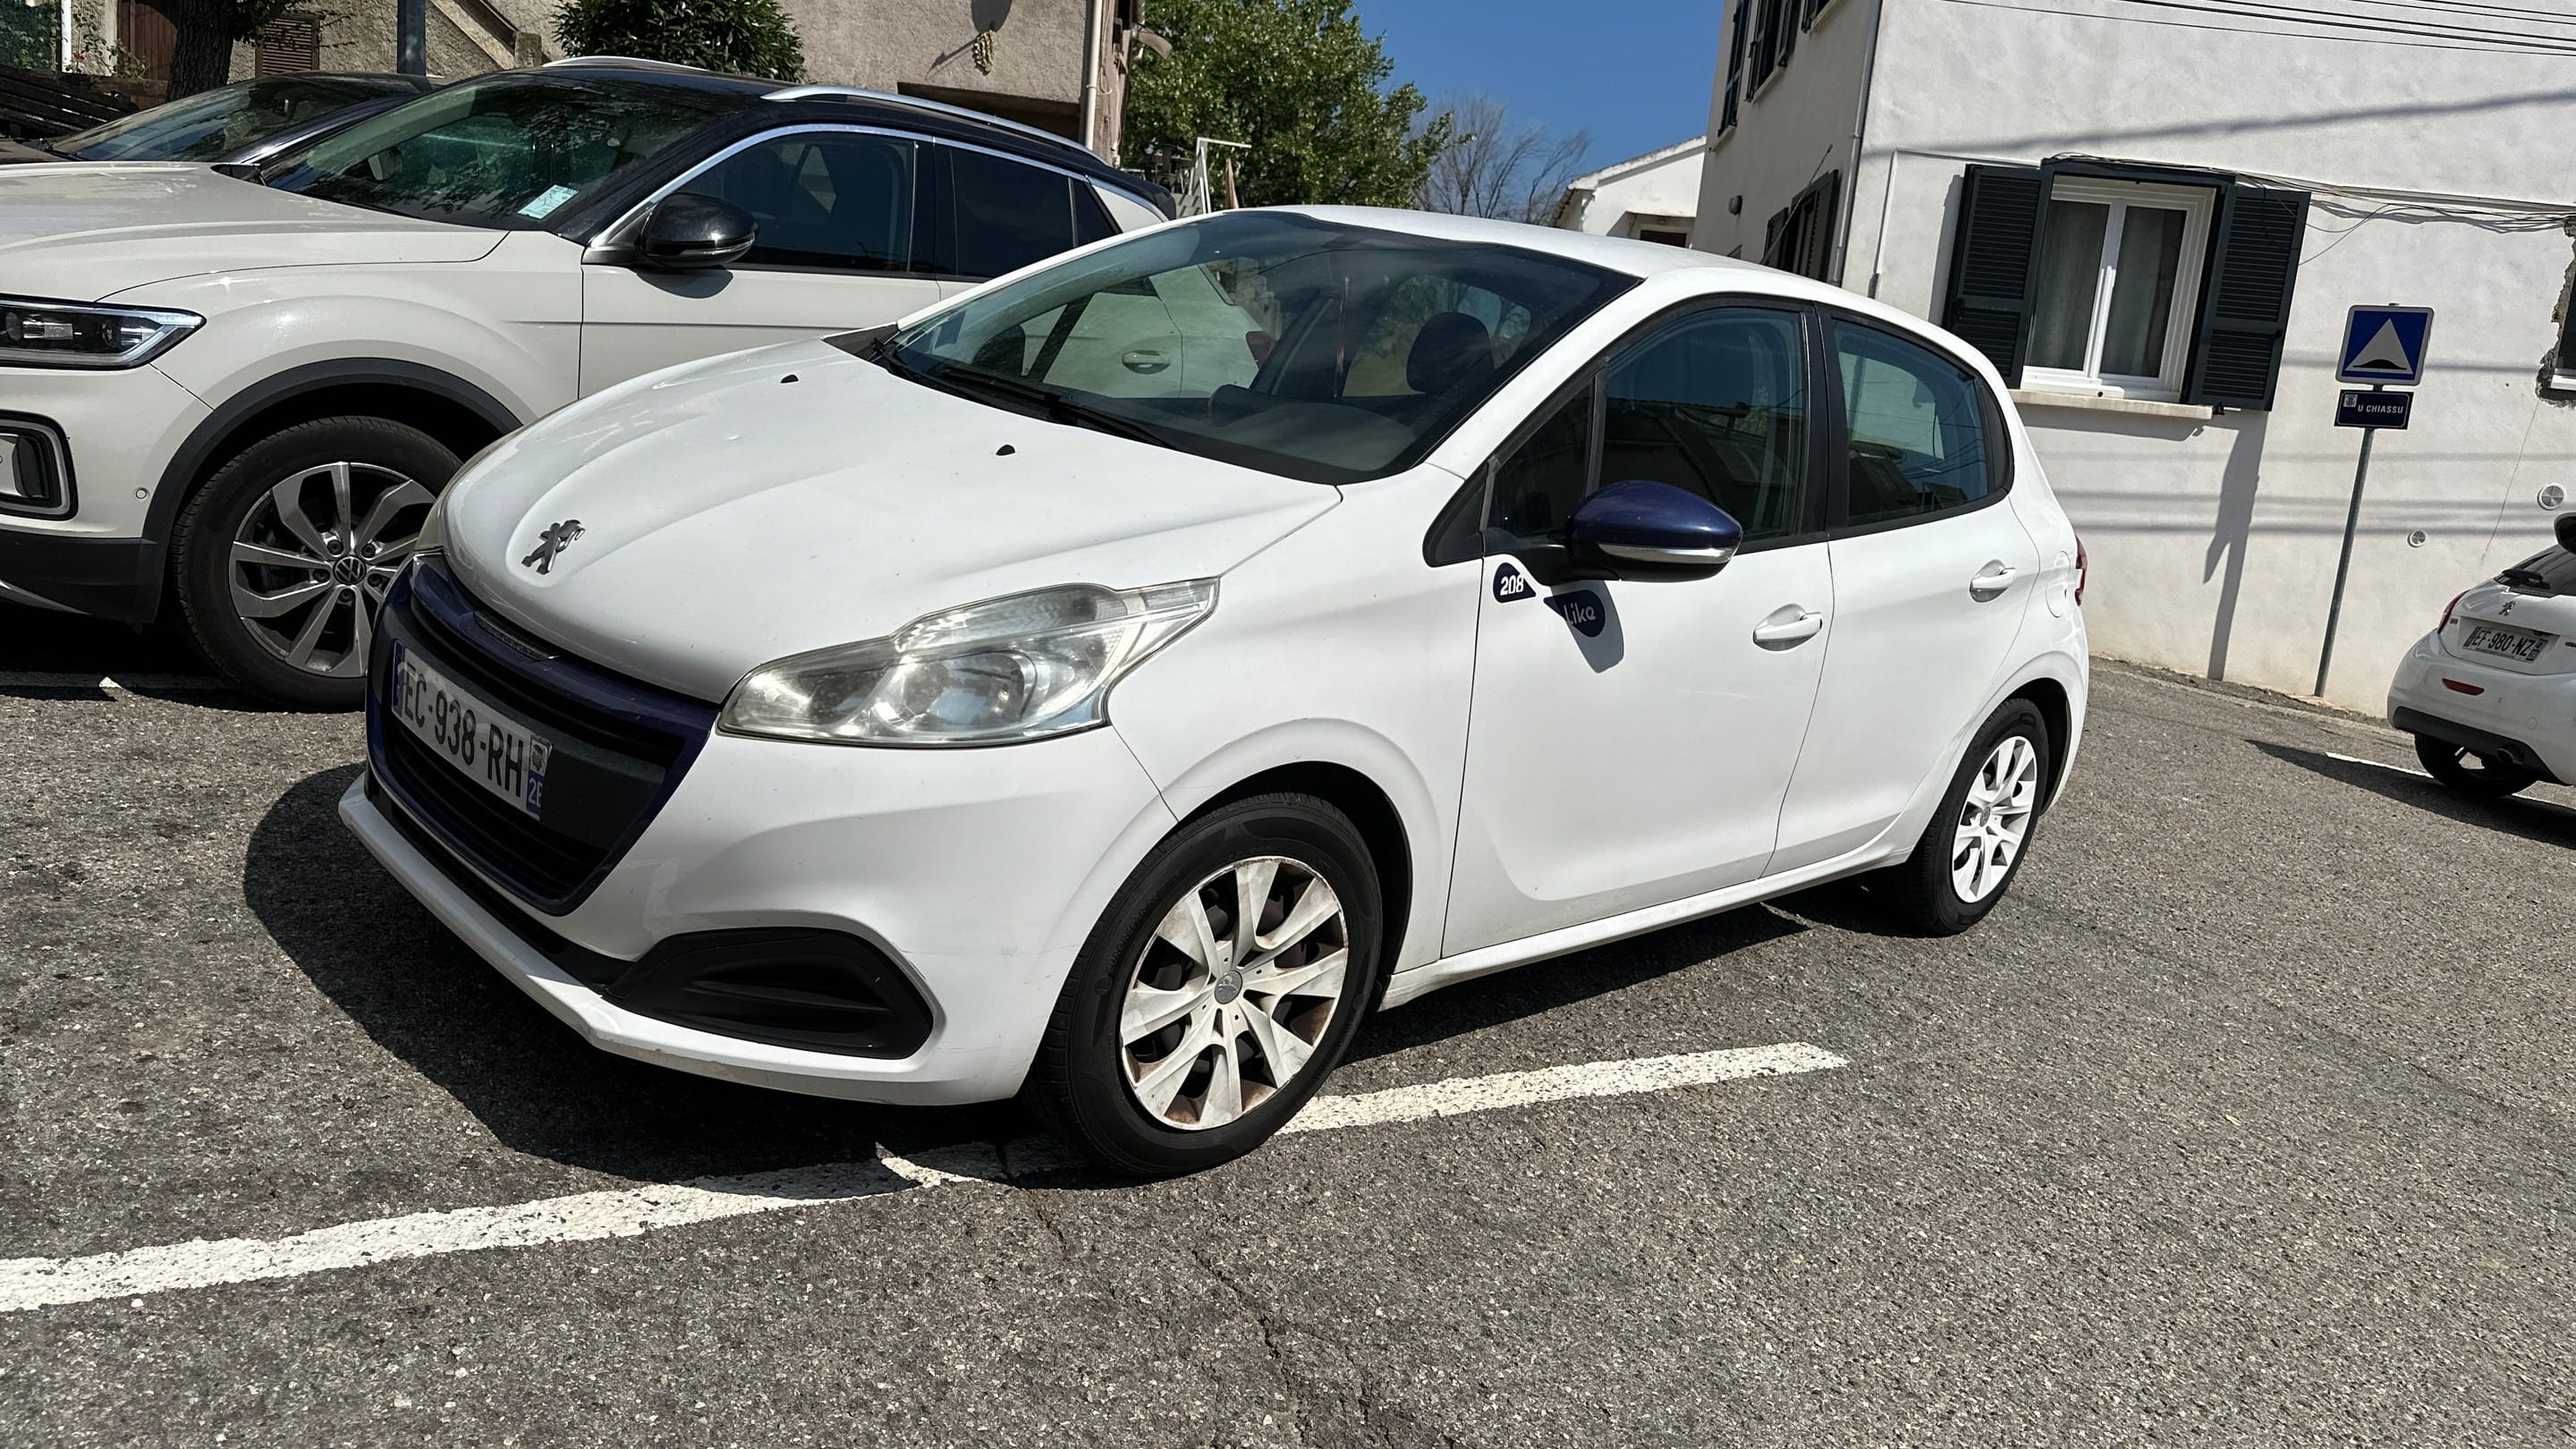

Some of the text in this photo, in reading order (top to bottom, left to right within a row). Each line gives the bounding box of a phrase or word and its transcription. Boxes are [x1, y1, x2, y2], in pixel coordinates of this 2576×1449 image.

[2357, 404, 2404, 413] U CHIASSU
[1500, 574, 1525, 596] 208
[2471, 629, 2537, 657] EF-980-NZ
[404, 662, 524, 798] EC-938-RH
